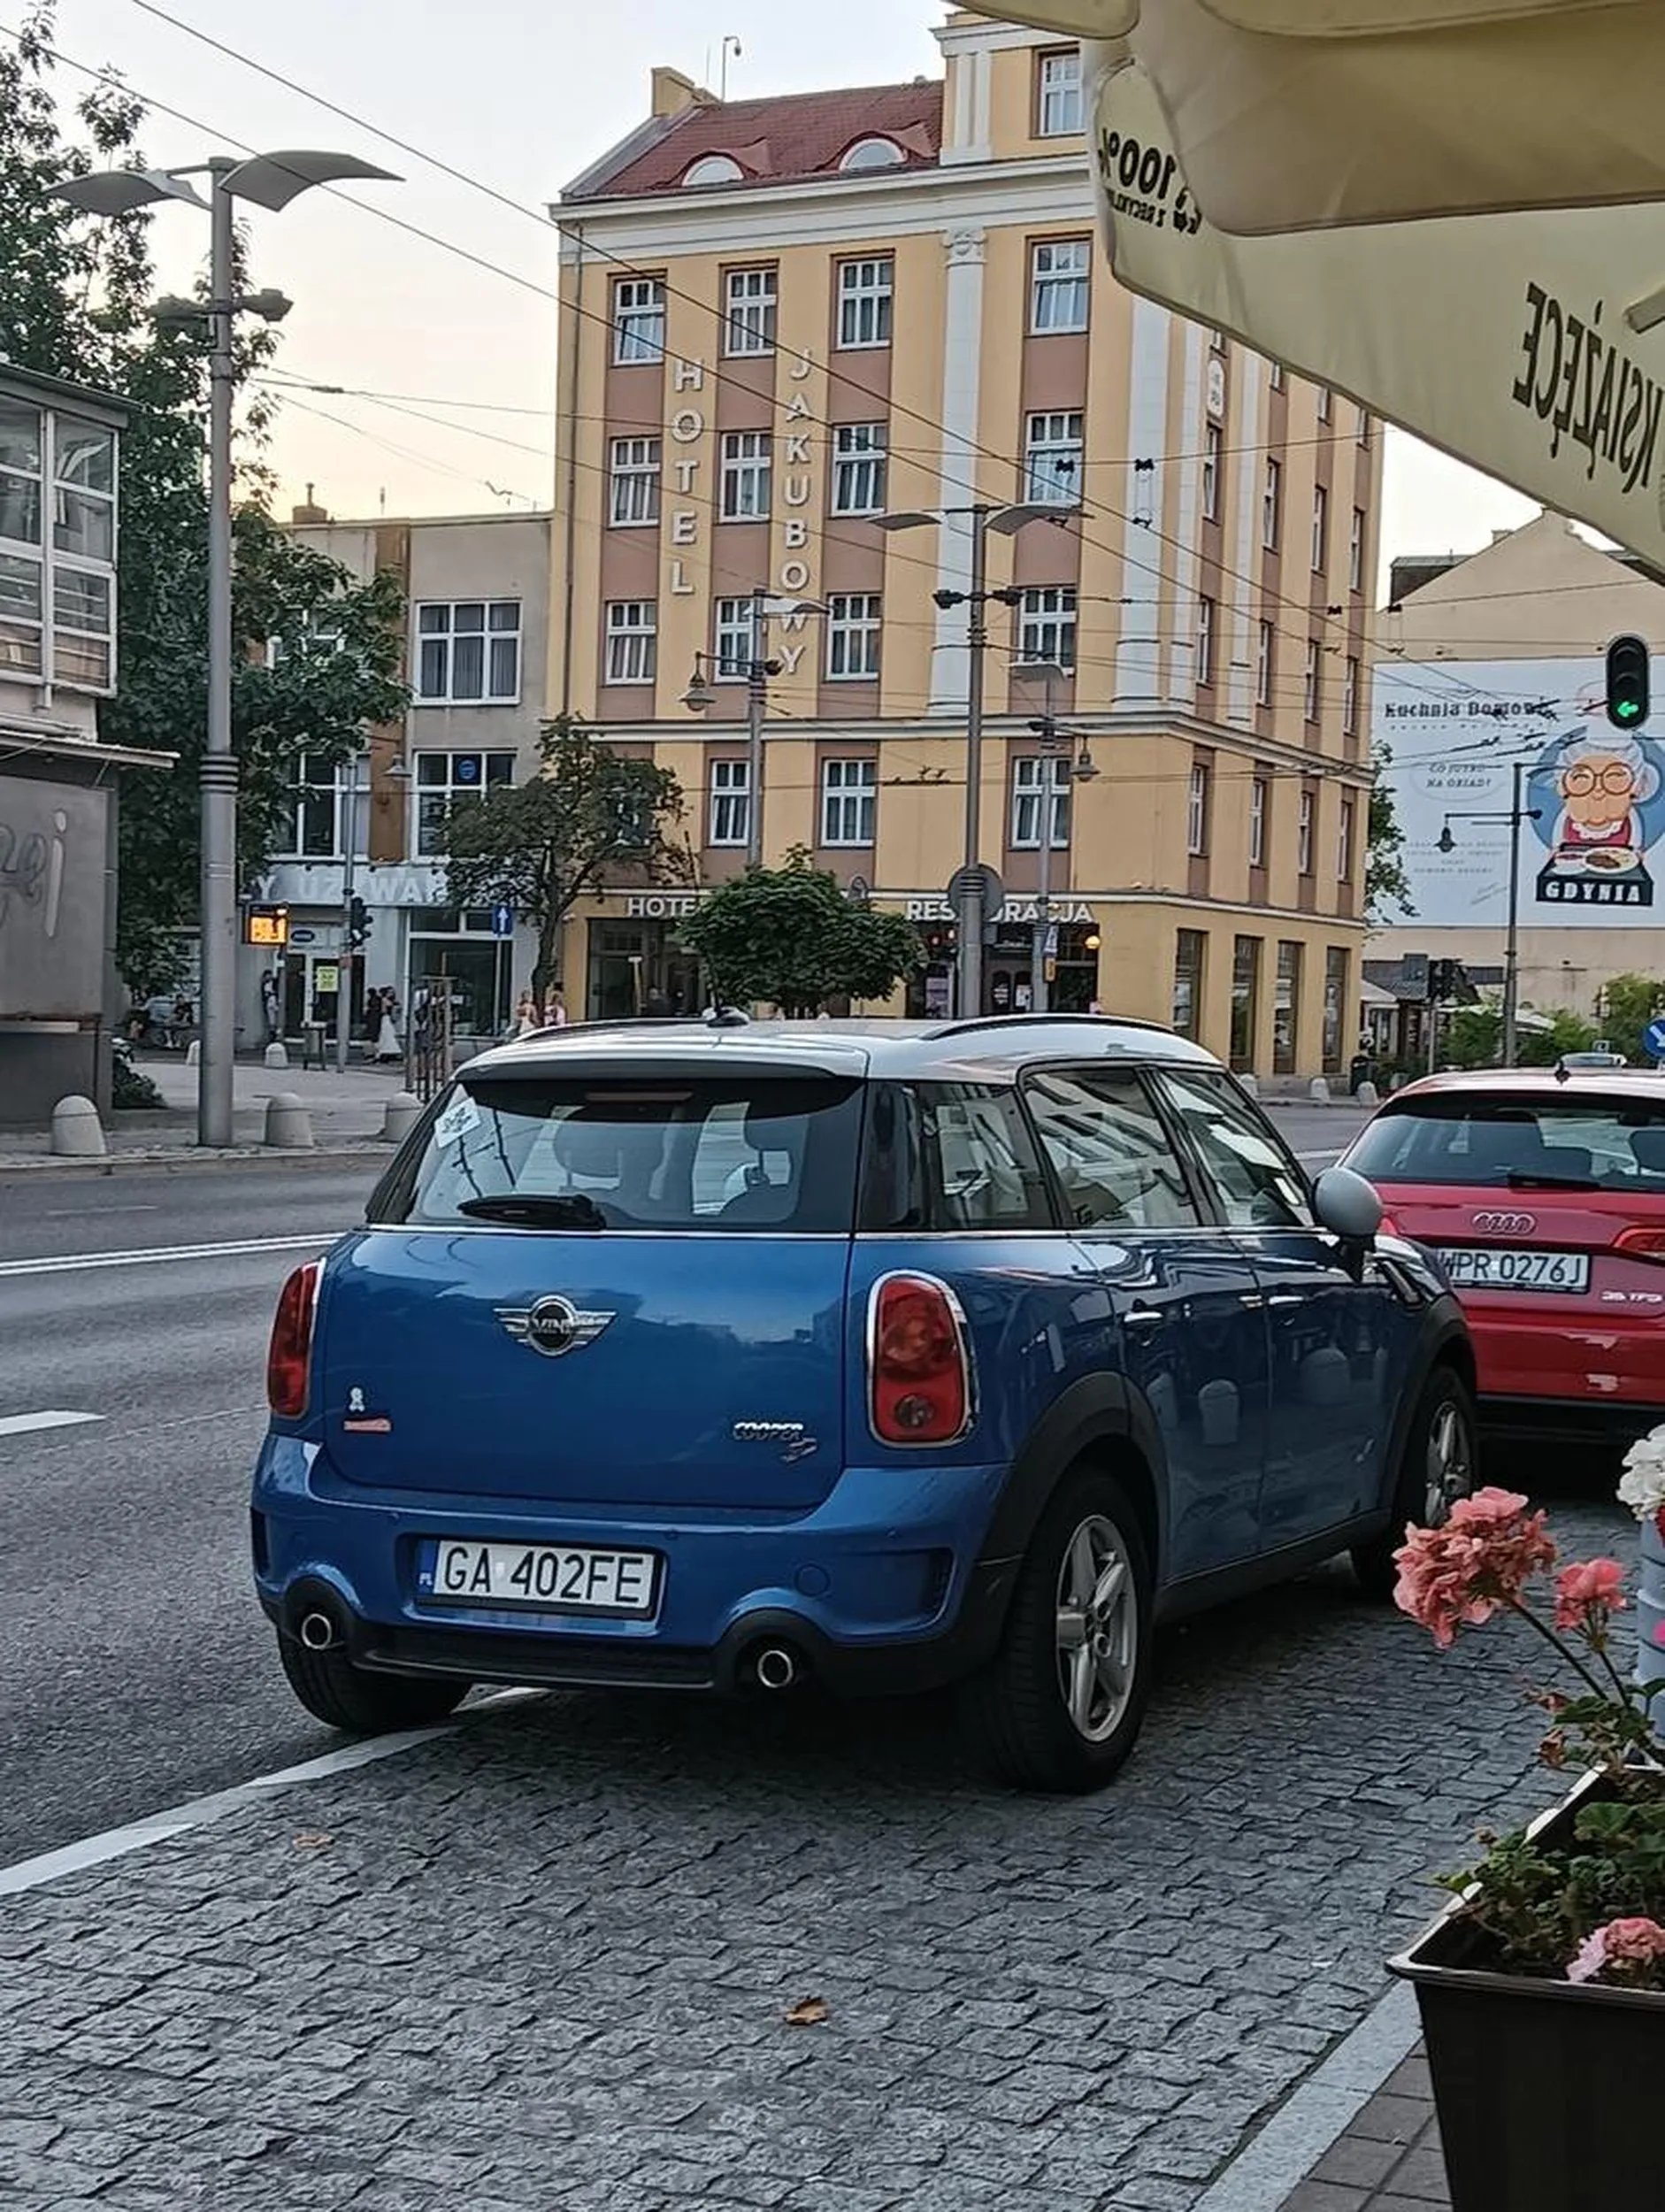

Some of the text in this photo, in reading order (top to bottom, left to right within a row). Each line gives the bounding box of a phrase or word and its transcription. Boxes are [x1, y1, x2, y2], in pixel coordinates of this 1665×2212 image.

[671, 357, 704, 595] HOTEL
[1385, 702, 1460, 718] Kuchnia
[1545, 881, 1640, 902] GDYNIA
[1499, 1253, 1583, 1284] 0276J
[444, 1546, 645, 1603] GA 402FE
